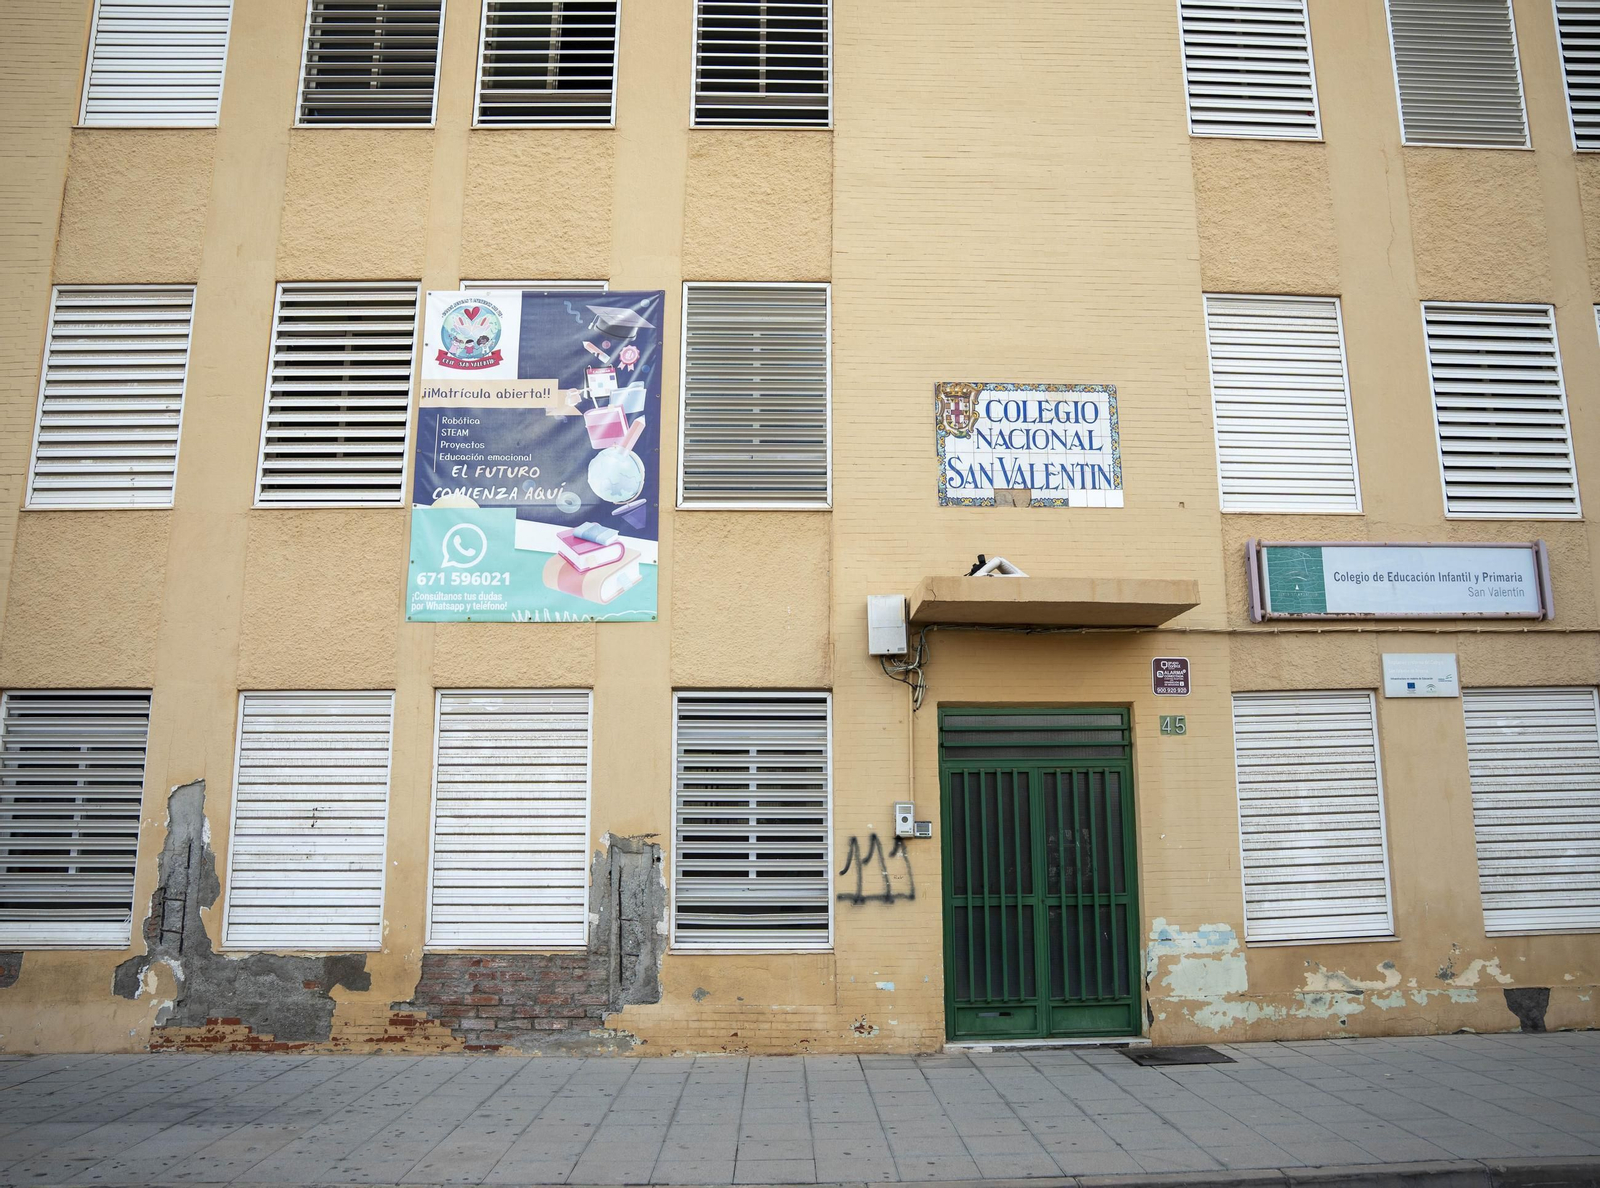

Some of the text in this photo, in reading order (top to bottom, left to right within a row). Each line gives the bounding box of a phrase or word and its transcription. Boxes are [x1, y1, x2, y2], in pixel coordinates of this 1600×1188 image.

[496, 388, 551, 399] abierta!!
[985, 398, 1099, 425] COLEGIO
[441, 416, 480, 425] Robótica
[441, 428, 469, 437] STEAM
[440, 440, 485, 450] Proyectos
[975, 427, 1104, 452] NACIONAL
[440, 452, 532, 462] Educación emocional
[475, 465, 540, 479] FUTURO
[432, 481, 566, 500] COMIENZA AQUÍ
[416, 571, 511, 586] 671 596021
[1333, 571, 1523, 585] Colegio de Educación Infantil y Primaria
[411, 591, 503, 603] ¡Consúltanos tus dudas
[1467, 586, 1525, 598] San Valentín
[410, 601, 508, 613] por Whatsapp y teléfono!
[1161, 716, 1186, 734] 45
